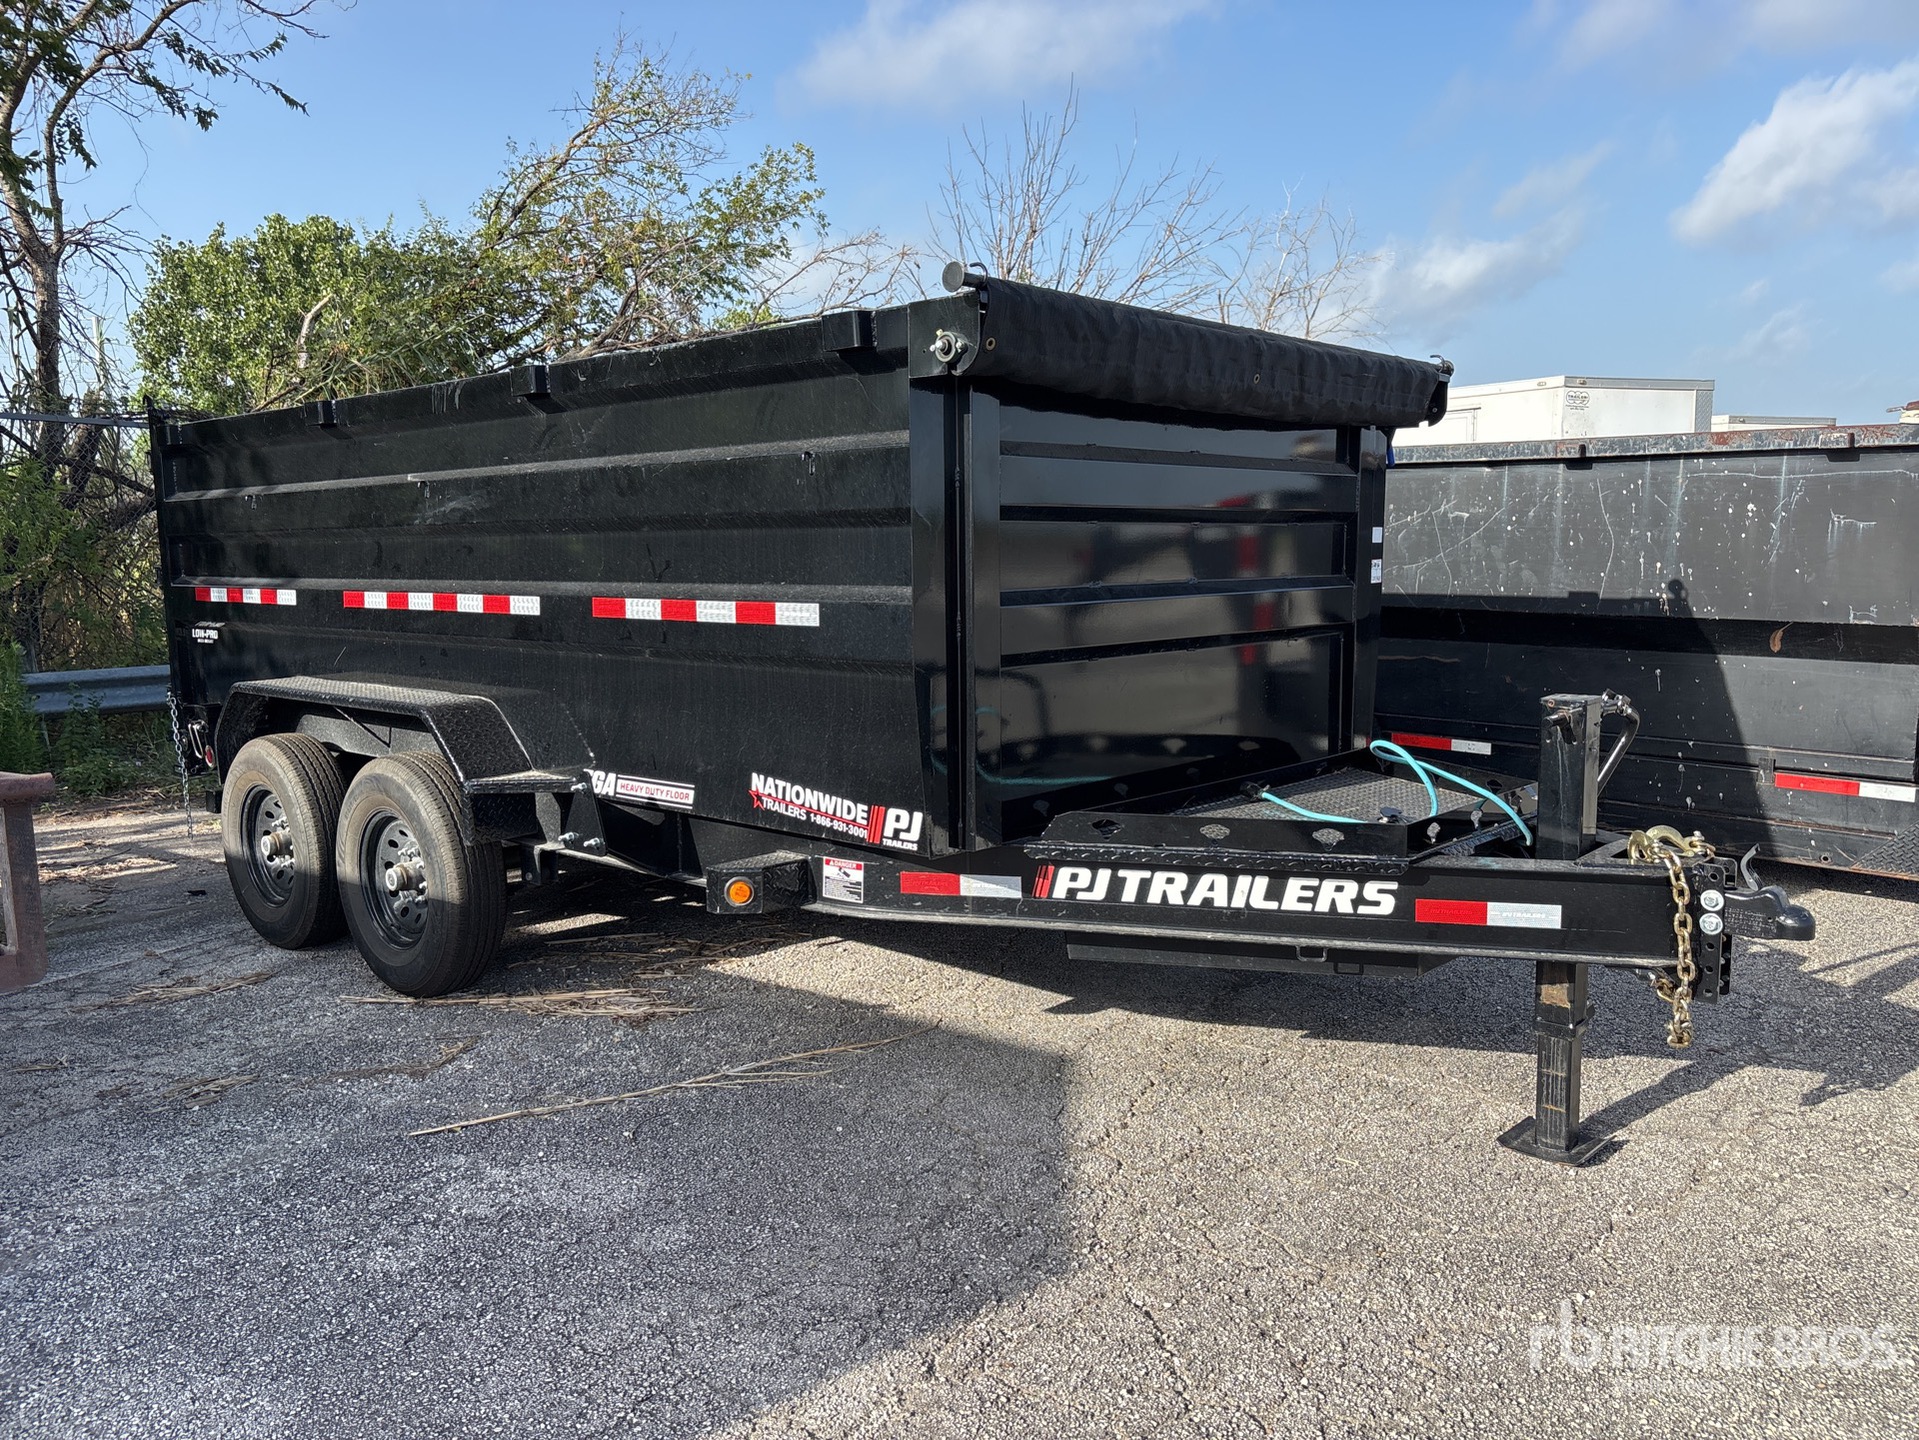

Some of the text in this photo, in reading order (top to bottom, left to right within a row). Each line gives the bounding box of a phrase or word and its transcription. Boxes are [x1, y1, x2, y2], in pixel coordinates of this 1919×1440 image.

[620, 783, 690, 801] HEAVY DUTY FLOOR
[751, 772, 869, 825] NATIONWIDE
[762, 797, 868, 840] TRAILERS 1-866-931-3001
[883, 807, 923, 842] PJ
[882, 838, 918, 851] TRAILERS
[1117, 869, 1399, 916] TRAILERS
